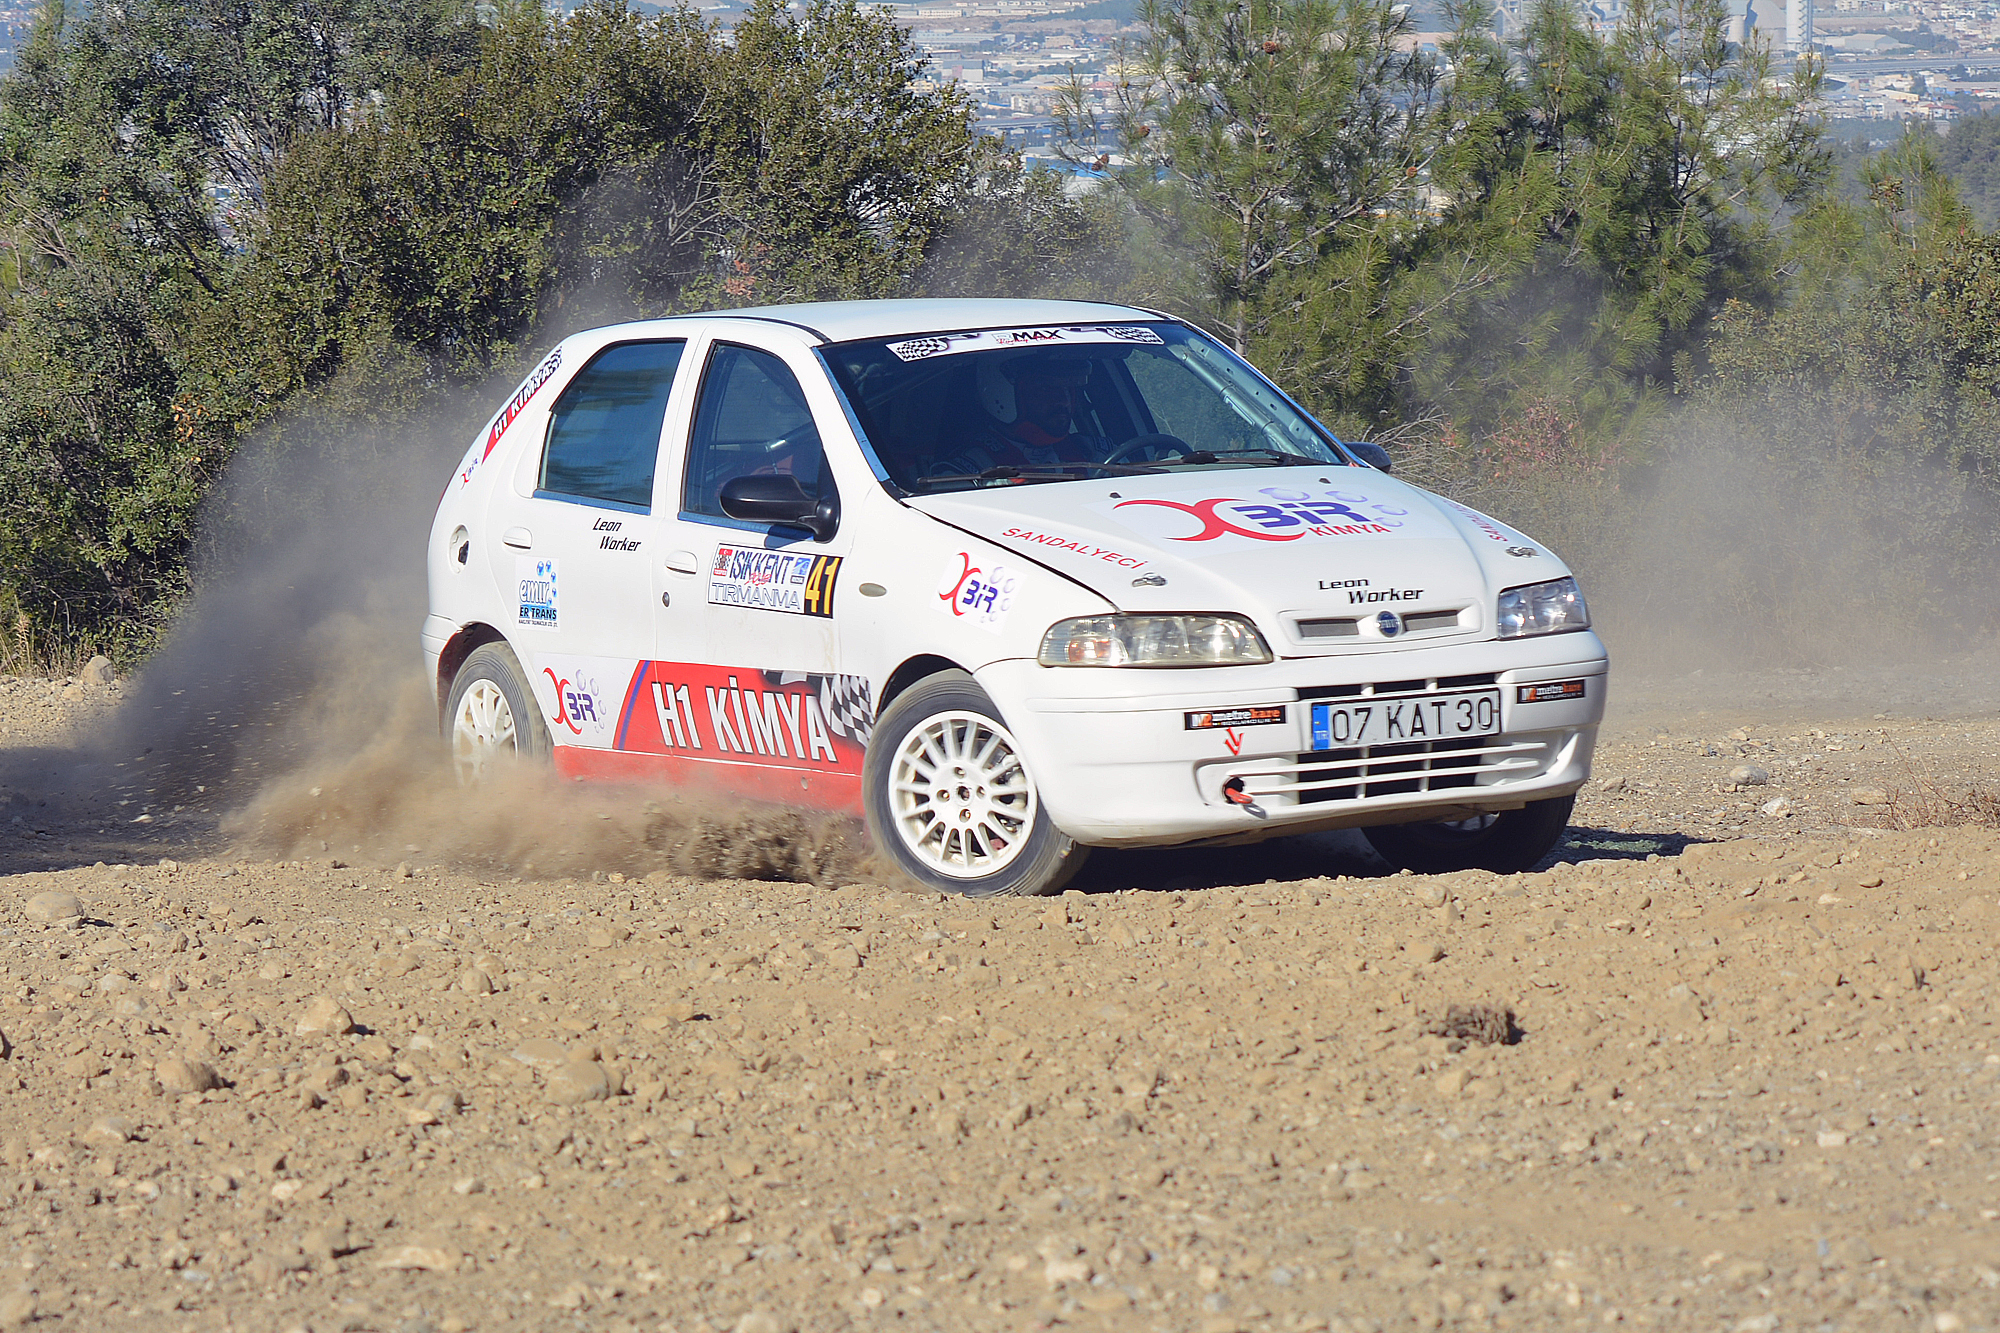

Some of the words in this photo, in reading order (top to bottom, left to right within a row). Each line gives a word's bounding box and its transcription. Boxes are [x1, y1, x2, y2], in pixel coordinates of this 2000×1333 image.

[494, 412, 508, 440] H1
[593, 517, 623, 532] Leon
[599, 535, 642, 552] Worker
[1002, 527, 1149, 569] SANDALYECİ
[711, 582, 801, 610] TIRMANMA
[805, 556, 840, 615] 41
[1318, 578, 1369, 590] Leon
[1348, 587, 1425, 604] Worker
[519, 606, 530, 618] ER
[531, 607, 558, 620] TRANS
[651, 681, 702, 749] H1
[704, 675, 839, 763] KİMYA
[1332, 706, 1373, 742] 07
[1386, 700, 1447, 739] KAT
[1456, 696, 1493, 732] 30
